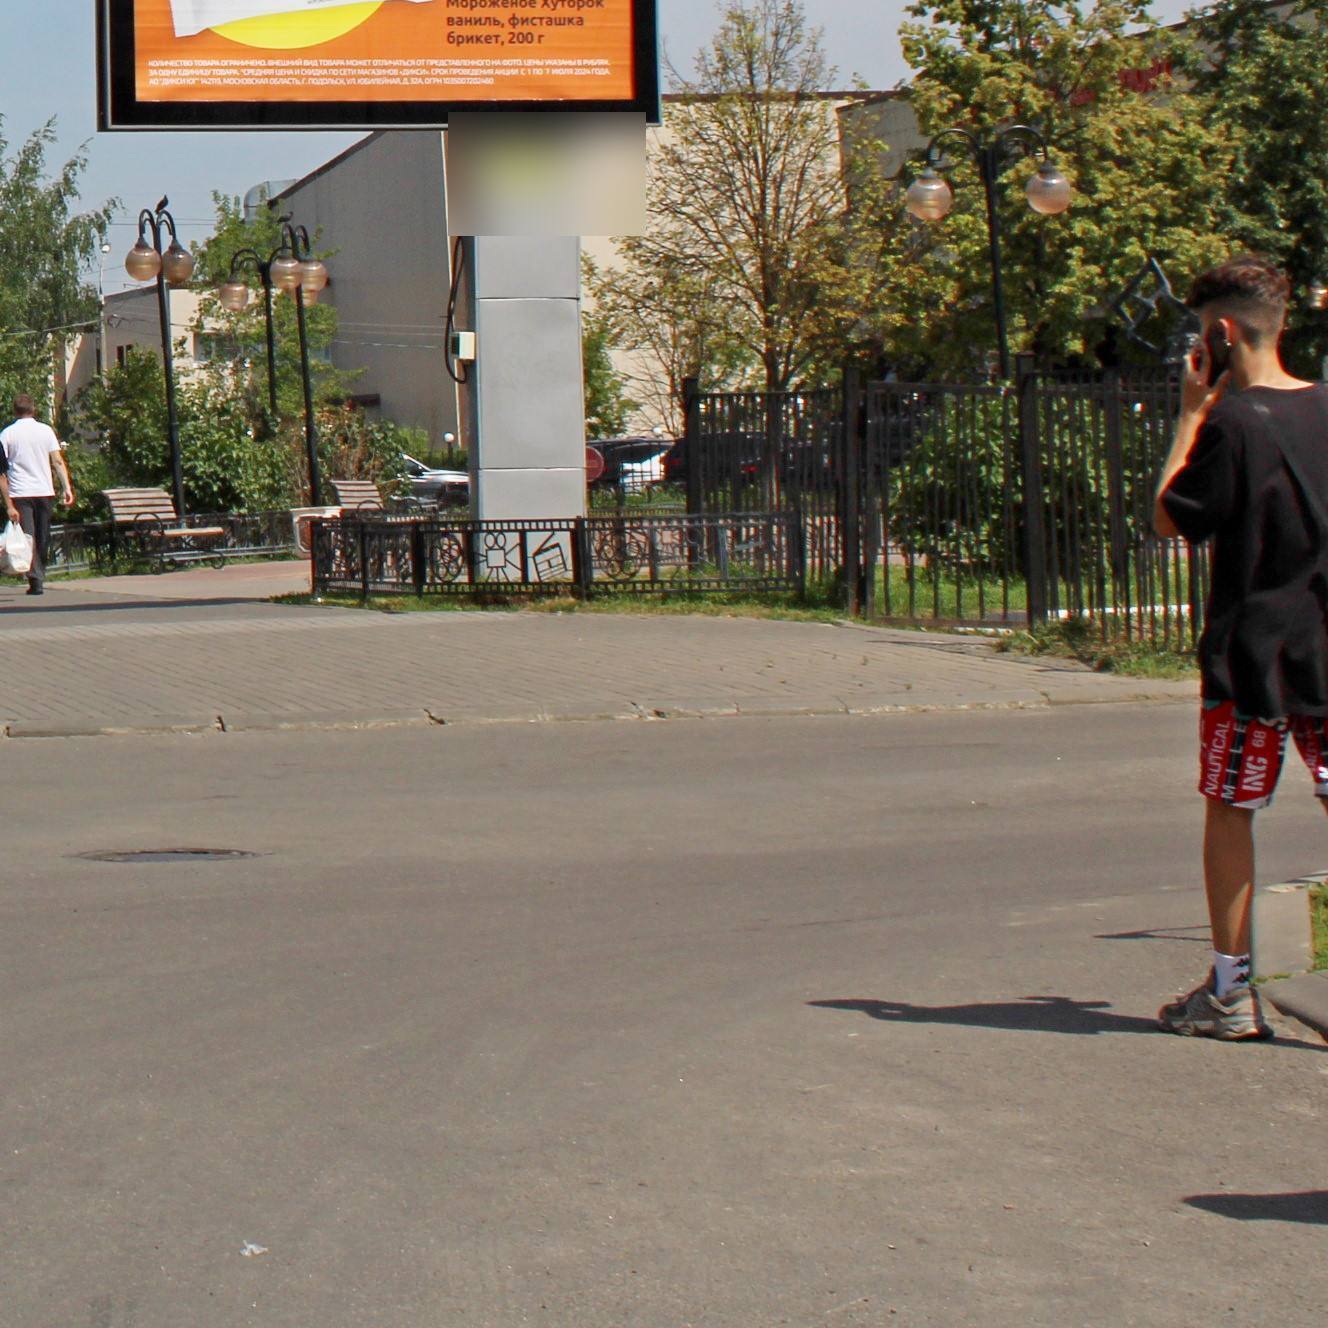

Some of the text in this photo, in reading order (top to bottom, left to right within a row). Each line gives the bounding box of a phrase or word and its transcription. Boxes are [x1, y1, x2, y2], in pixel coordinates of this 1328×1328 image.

[447, 13, 585, 29] ваниль, фисташка
[447, 31, 545, 46] брикет, 200 г
[1204, 720, 1233, 796] NAUTICAL
